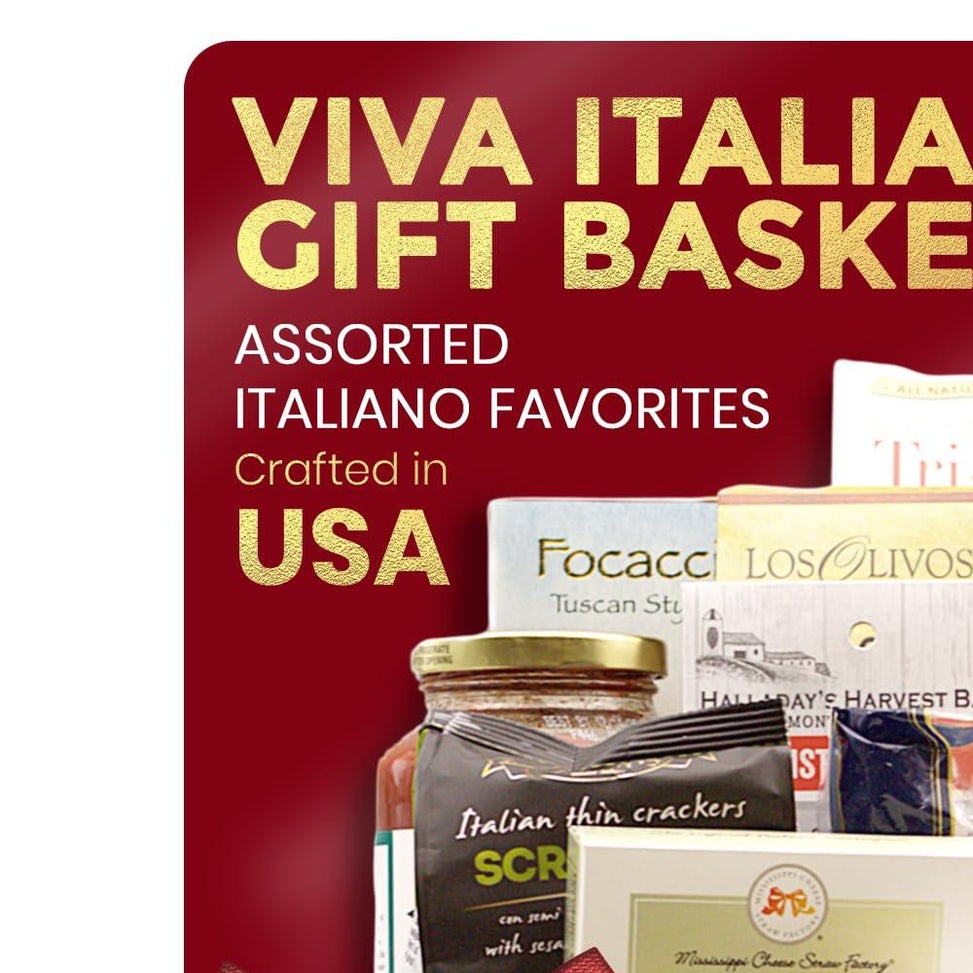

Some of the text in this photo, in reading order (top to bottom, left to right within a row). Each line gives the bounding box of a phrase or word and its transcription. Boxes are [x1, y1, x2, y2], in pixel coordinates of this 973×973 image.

[896, 384, 921, 395] ALL
[745, 547, 815, 579] LOS
[549, 592, 637, 614] Tuscan
[844, 689, 948, 709] HARVEST
[454, 791, 747, 841] Italian thin crackers
[499, 907, 563, 926] con semi
[484, 932, 523, 957] with
[674, 950, 750, 972] Mississippi
[751, 950, 796, 970] Cheese
[798, 952, 843, 970] Straw
